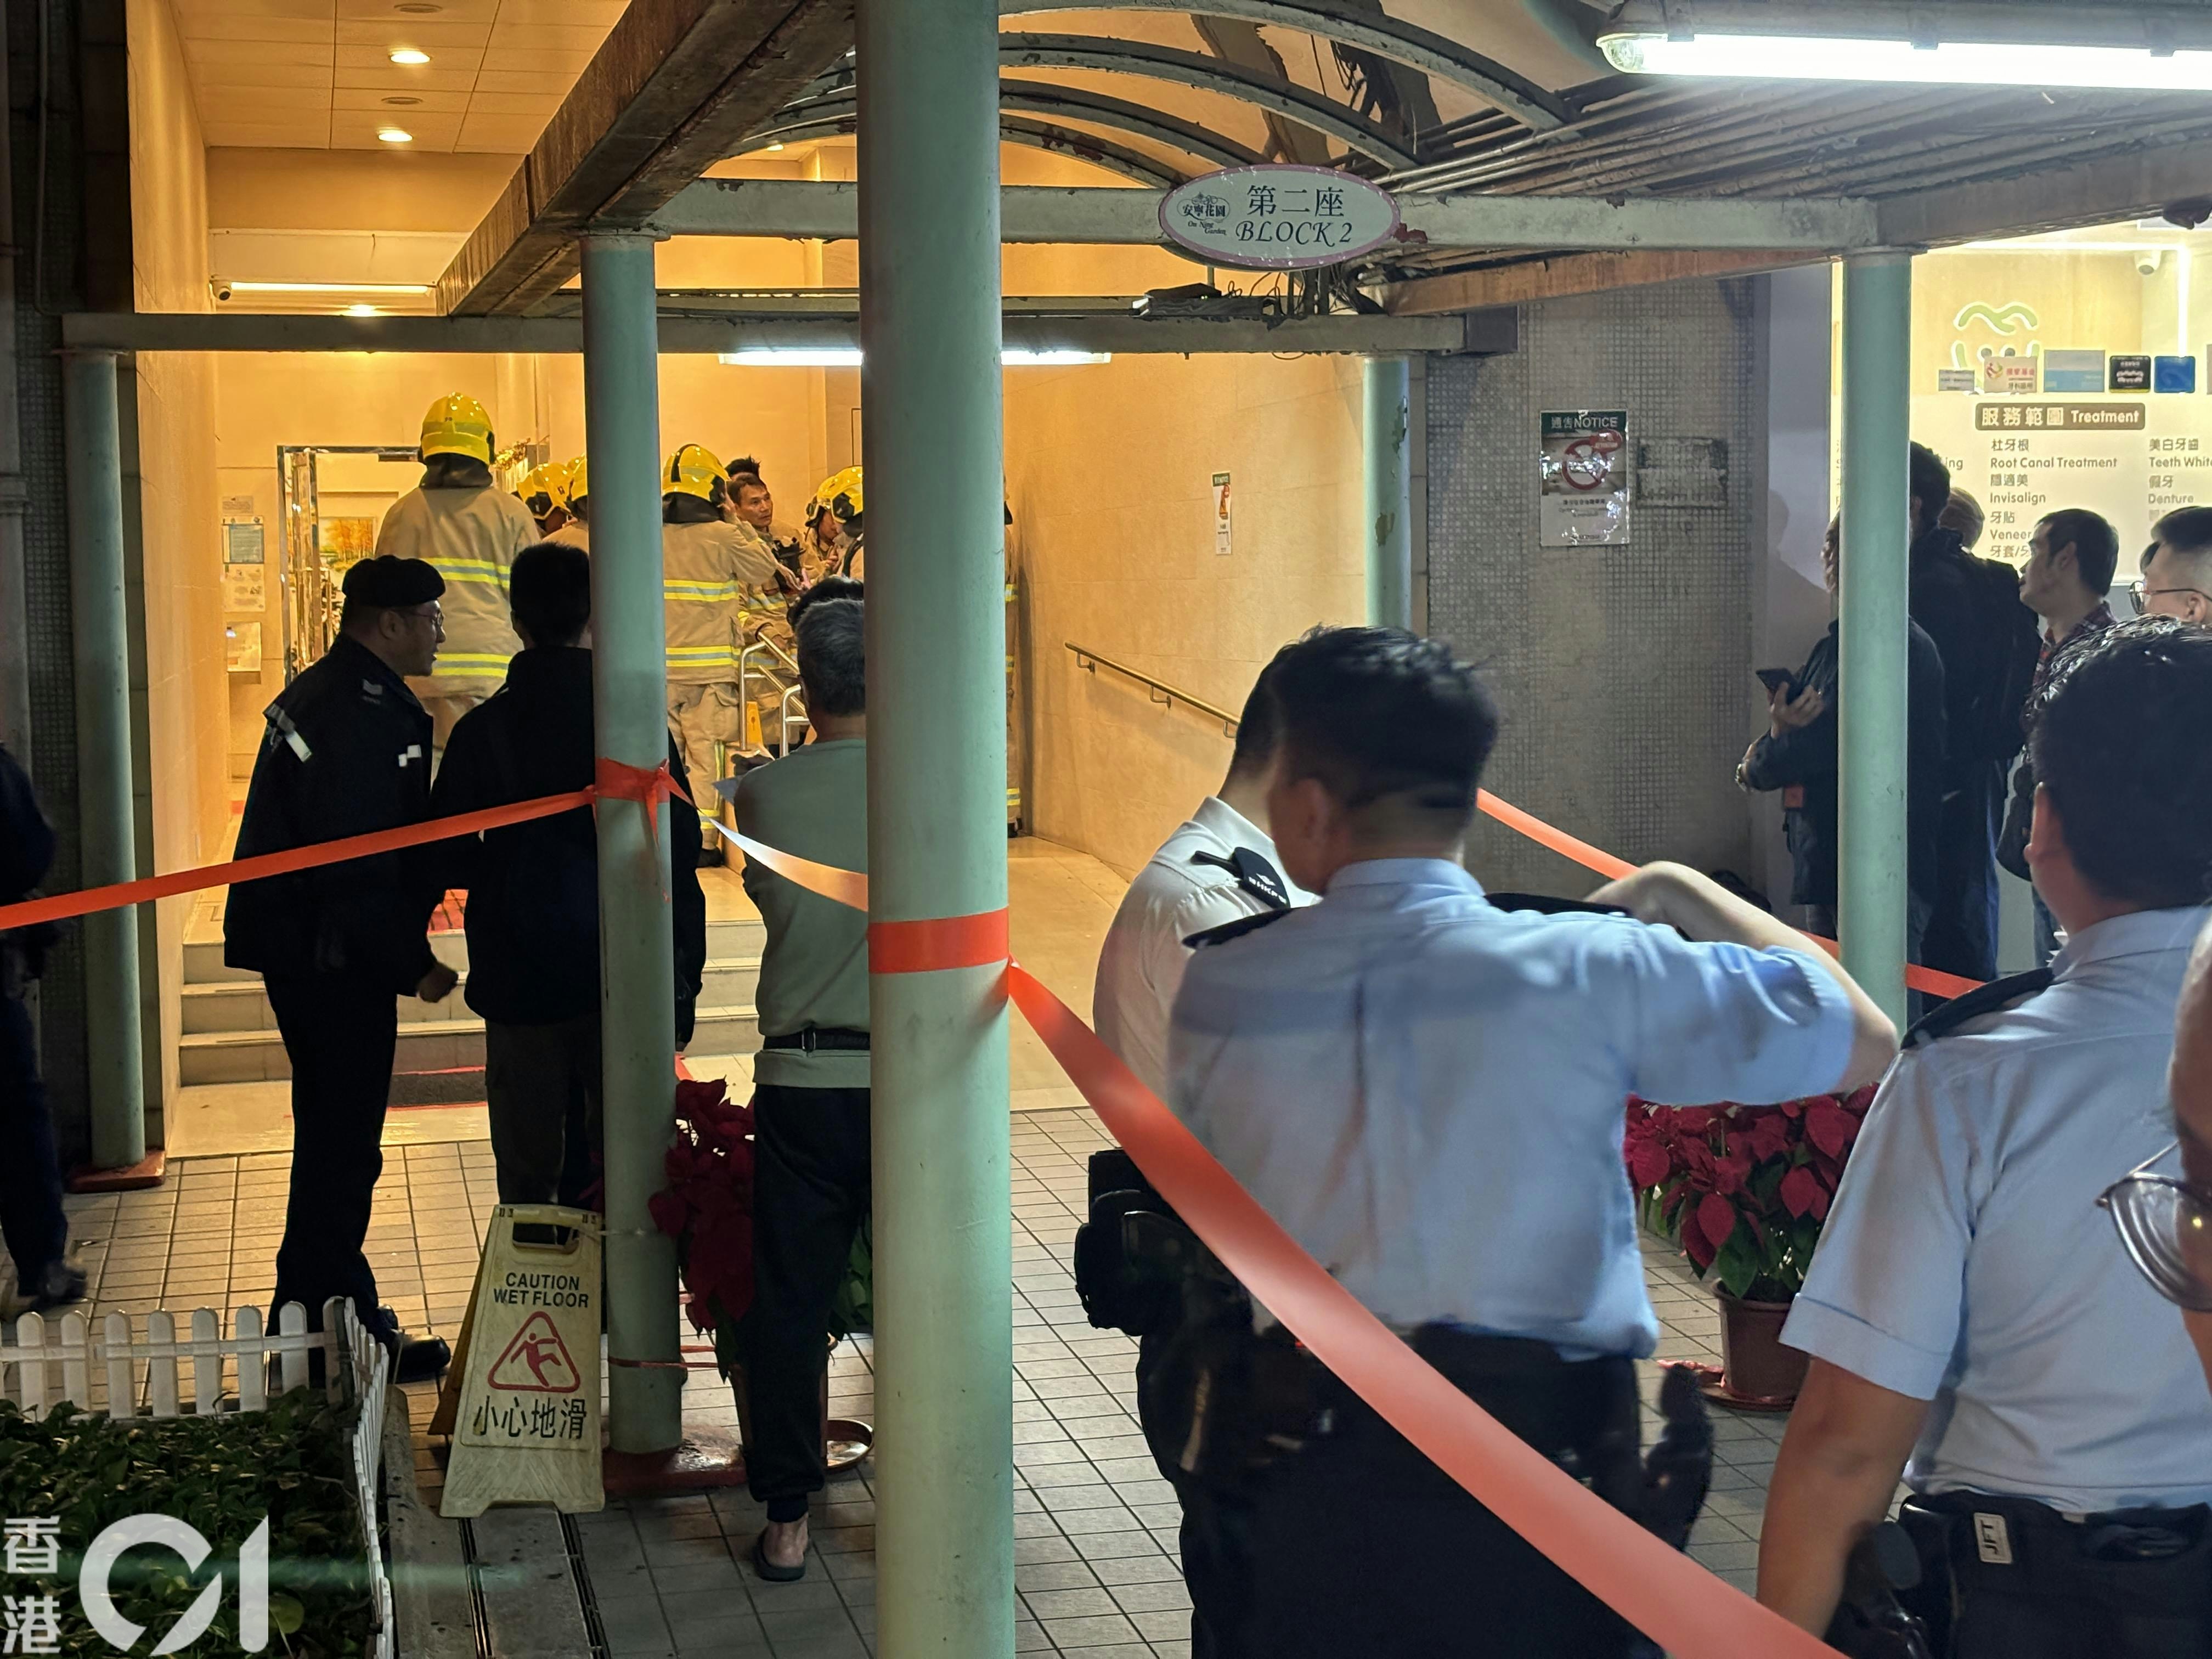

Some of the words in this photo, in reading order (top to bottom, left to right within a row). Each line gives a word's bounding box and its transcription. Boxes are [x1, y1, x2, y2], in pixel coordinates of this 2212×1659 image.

[1246, 185, 1344, 217] 第二座
[1235, 221, 1335, 247] BLOCK
[1339, 222, 1352, 242] 2
[1574, 417, 1618, 428] NOTICE
[2071, 410, 2140, 423] Treatment
[1991, 439, 2029, 452] 杜牙根
[1945, 457, 1963, 470] ing
[1991, 458, 2017, 468] Root
[2020, 457, 2054, 468] Canal
[2057, 458, 2117, 468] Treatment
[2149, 456, 2181, 467] Teeth
[1990, 492, 2046, 505] Invisalign
[2148, 493, 2194, 504] Denture
[506, 1272, 579, 1290] CAUTION
[494, 1288, 529, 1305] WET
[532, 1290, 589, 1307] FLOOR
[473, 1395, 587, 1439] 小心地滑
